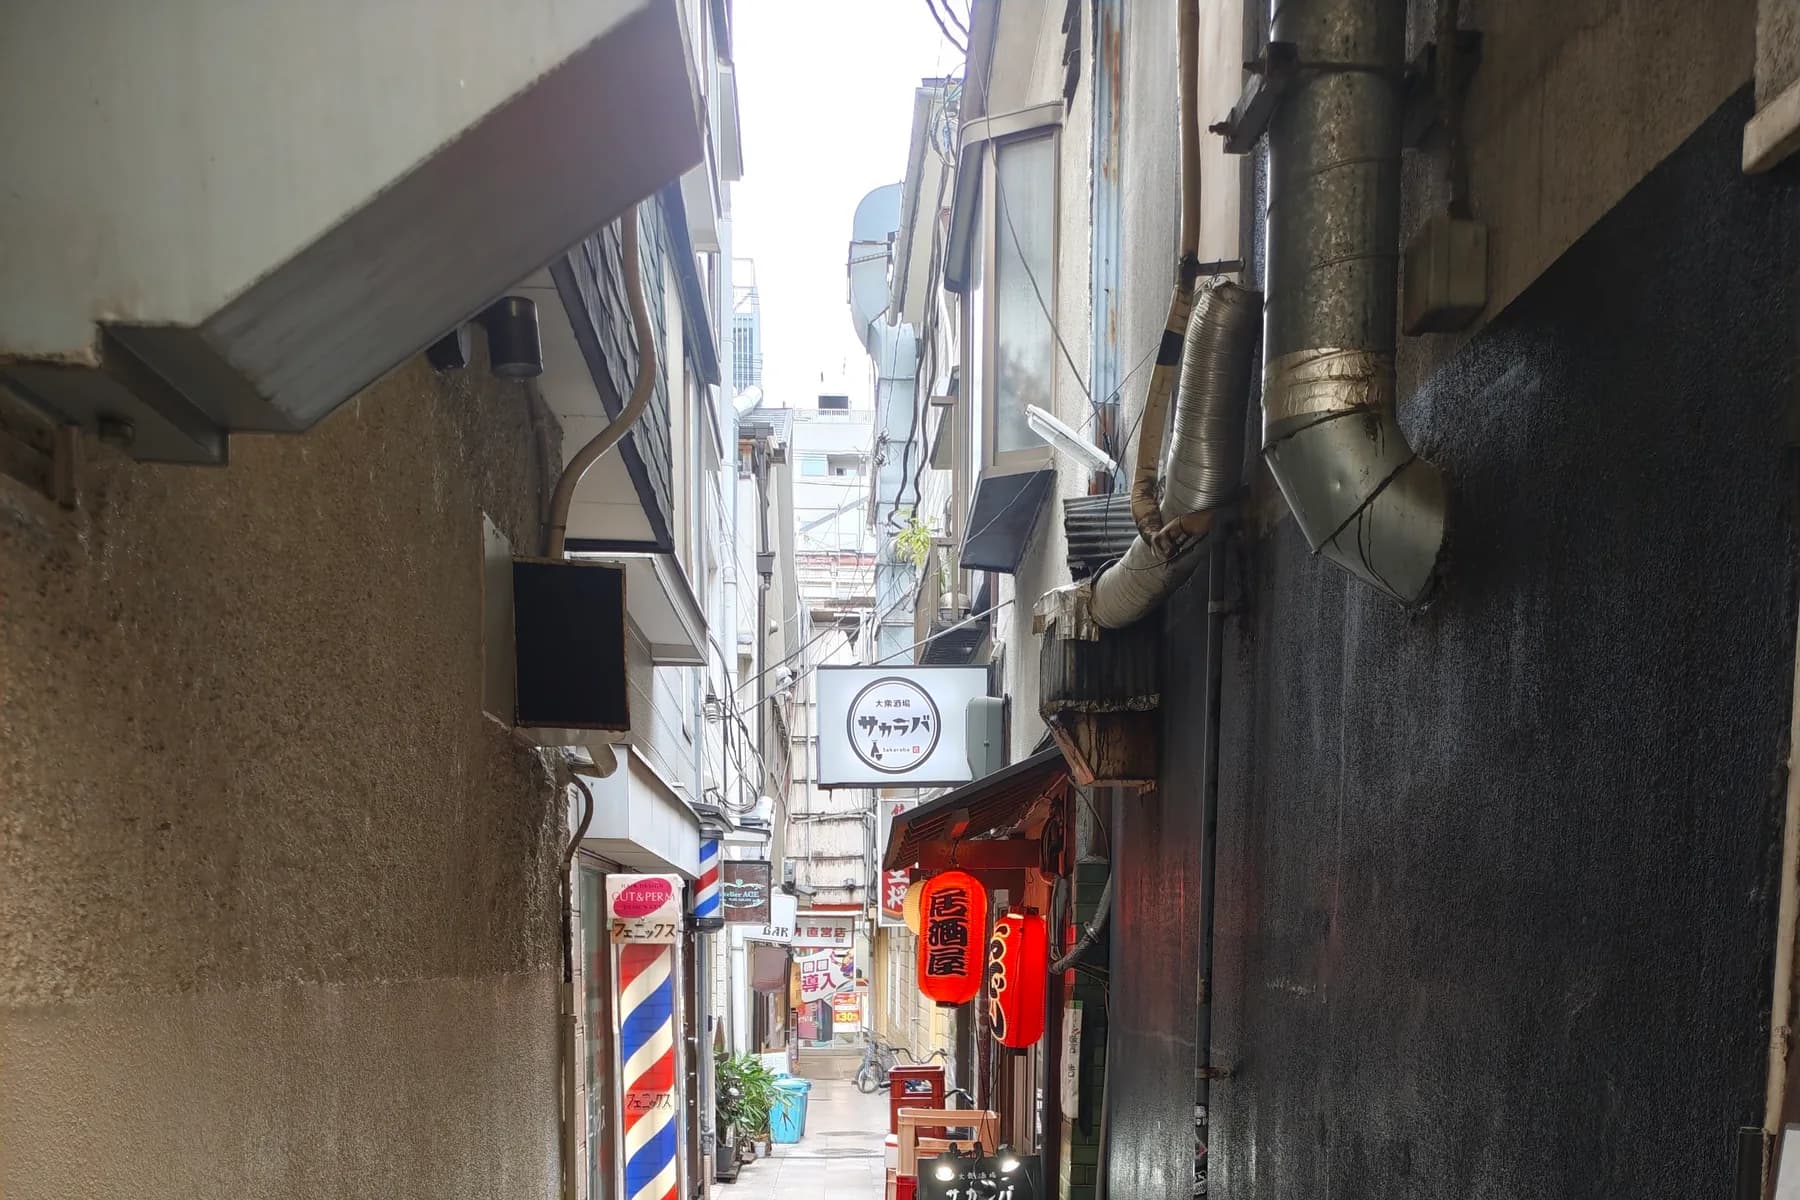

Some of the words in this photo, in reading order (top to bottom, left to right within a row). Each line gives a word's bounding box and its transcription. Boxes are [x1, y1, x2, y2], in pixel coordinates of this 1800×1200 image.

[875, 699, 911, 708] 大衆酒場
[858, 714, 930, 738] サカラバ
[613, 922, 676, 939] フェニックス
[762, 925, 789, 937] BAR
[926, 888, 969, 977] 居酒屋
[802, 972, 836, 992] 導入
[626, 1093, 672, 1111] フェニックス
